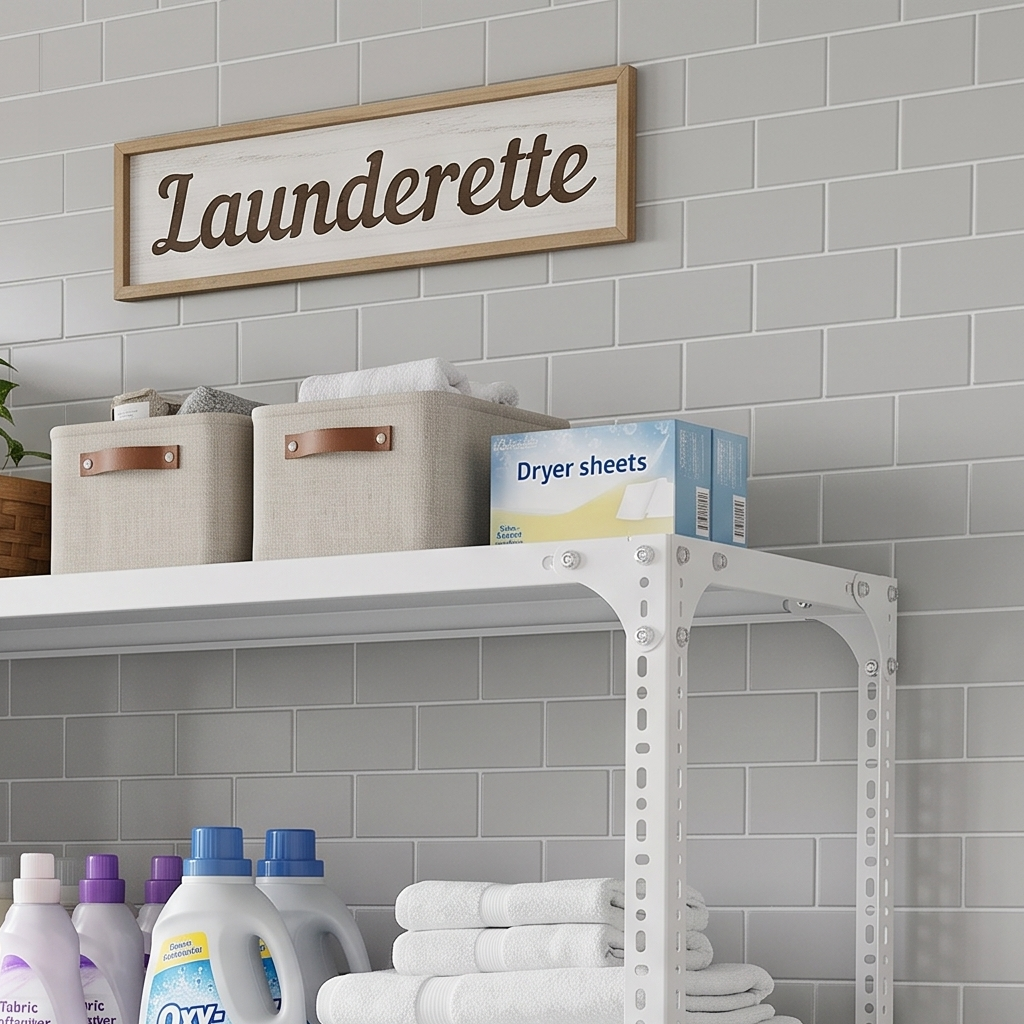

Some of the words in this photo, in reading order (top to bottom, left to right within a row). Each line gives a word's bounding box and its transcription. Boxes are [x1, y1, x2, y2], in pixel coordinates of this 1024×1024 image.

[151, 133, 597, 256] Launderette
[517, 461, 574, 485] Dryer
[579, 454, 647, 477] sheets
